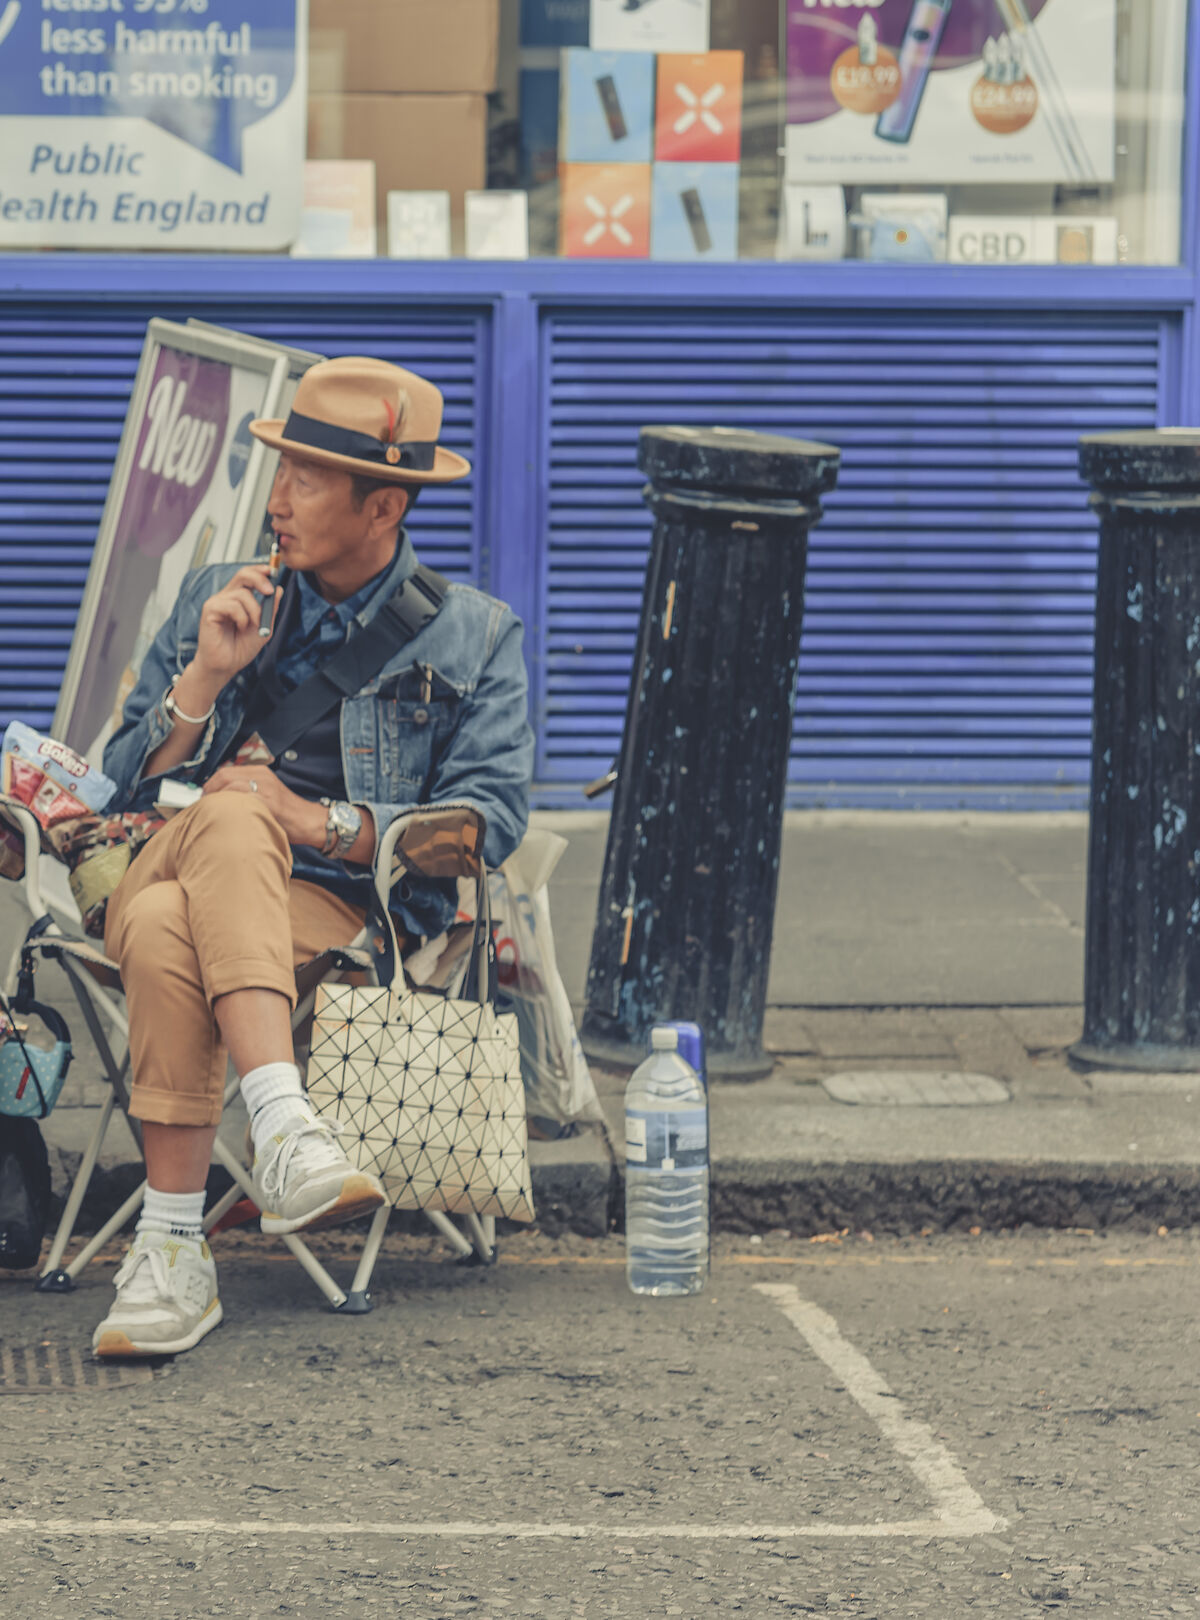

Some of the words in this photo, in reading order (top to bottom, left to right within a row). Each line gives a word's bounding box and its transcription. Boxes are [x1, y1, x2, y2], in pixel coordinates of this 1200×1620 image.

[41, 18, 107, 55] less
[115, 20, 251, 57] harmful
[39, 65, 125, 97] than
[129, 66, 278, 106] smoking
[29, 144, 145, 176] Public
[111, 192, 271, 231] England
[958, 233, 1026, 261] CBD
[138, 375, 218, 488] New
